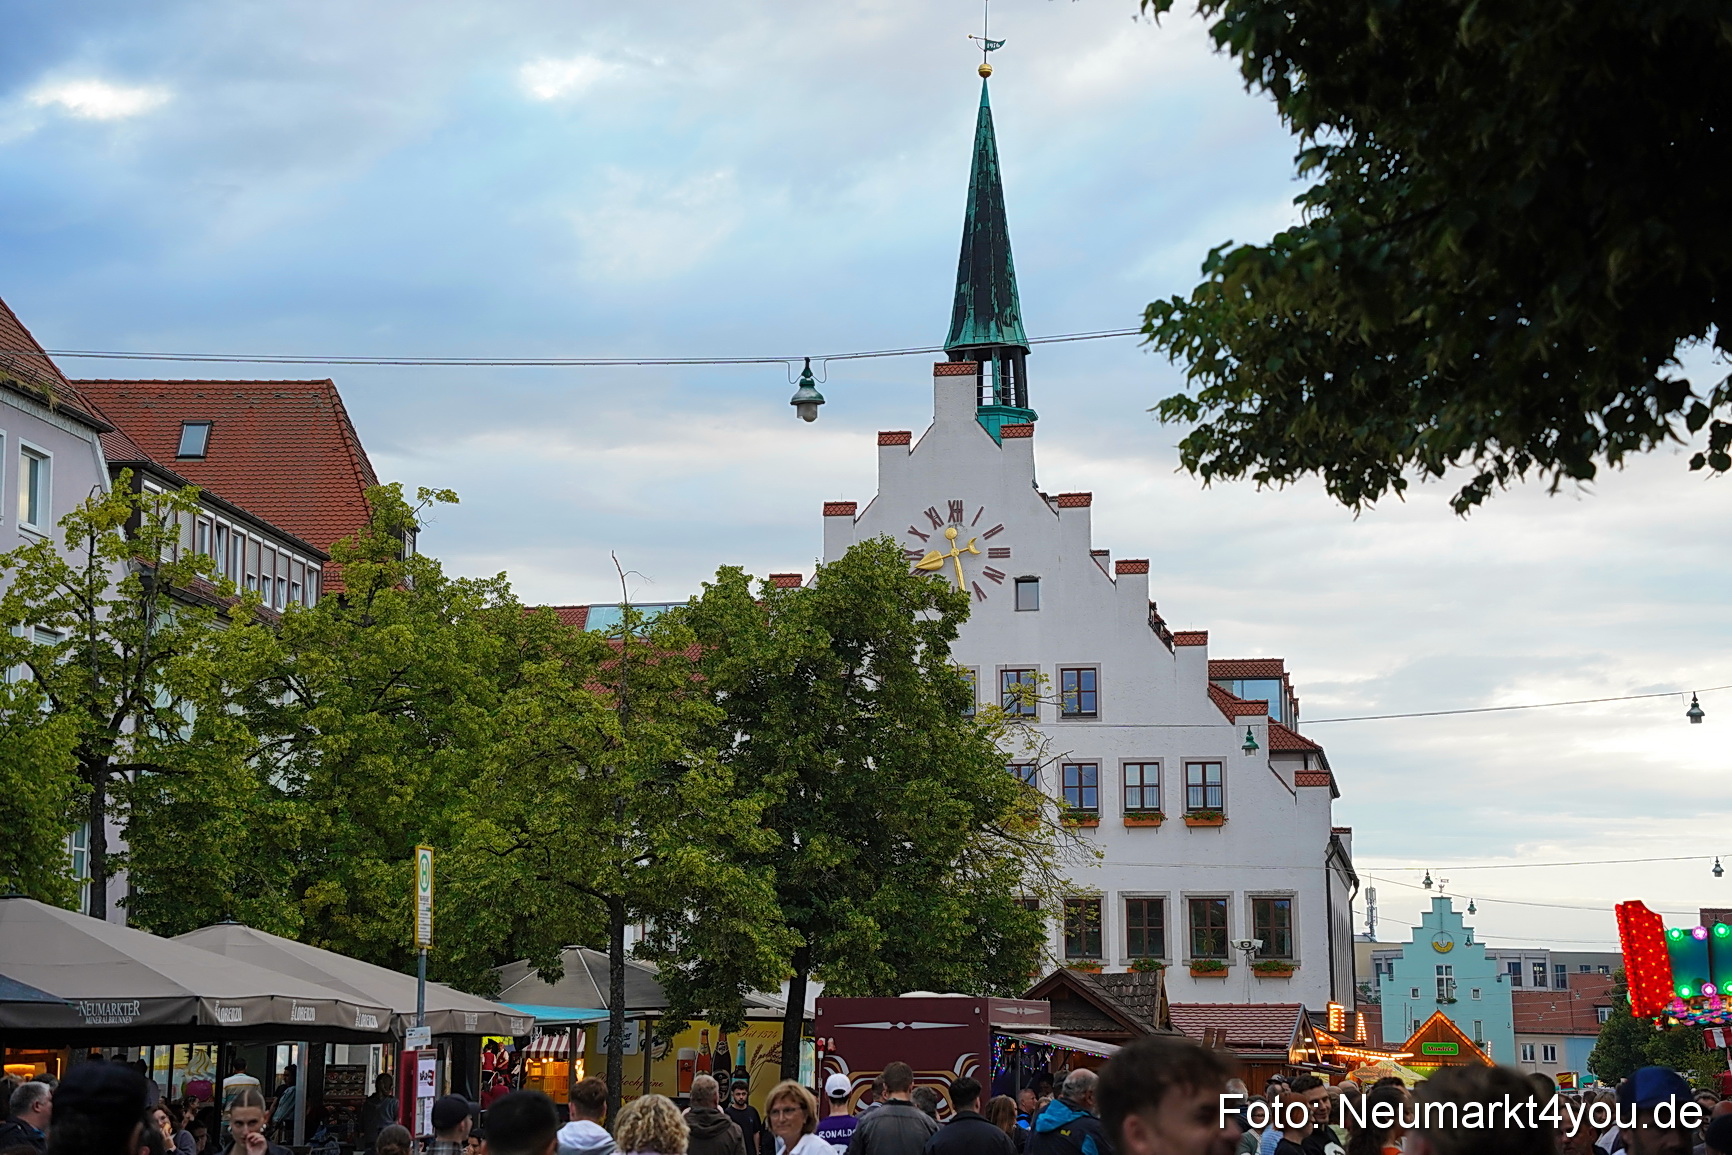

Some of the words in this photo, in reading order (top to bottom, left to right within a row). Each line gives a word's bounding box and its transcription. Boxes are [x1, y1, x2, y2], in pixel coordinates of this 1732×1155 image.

[79, 1000, 140, 1017] NEUMARKTER
[216, 1007, 243, 1023] LORENZO
[294, 1006, 316, 1022] LORENZO
